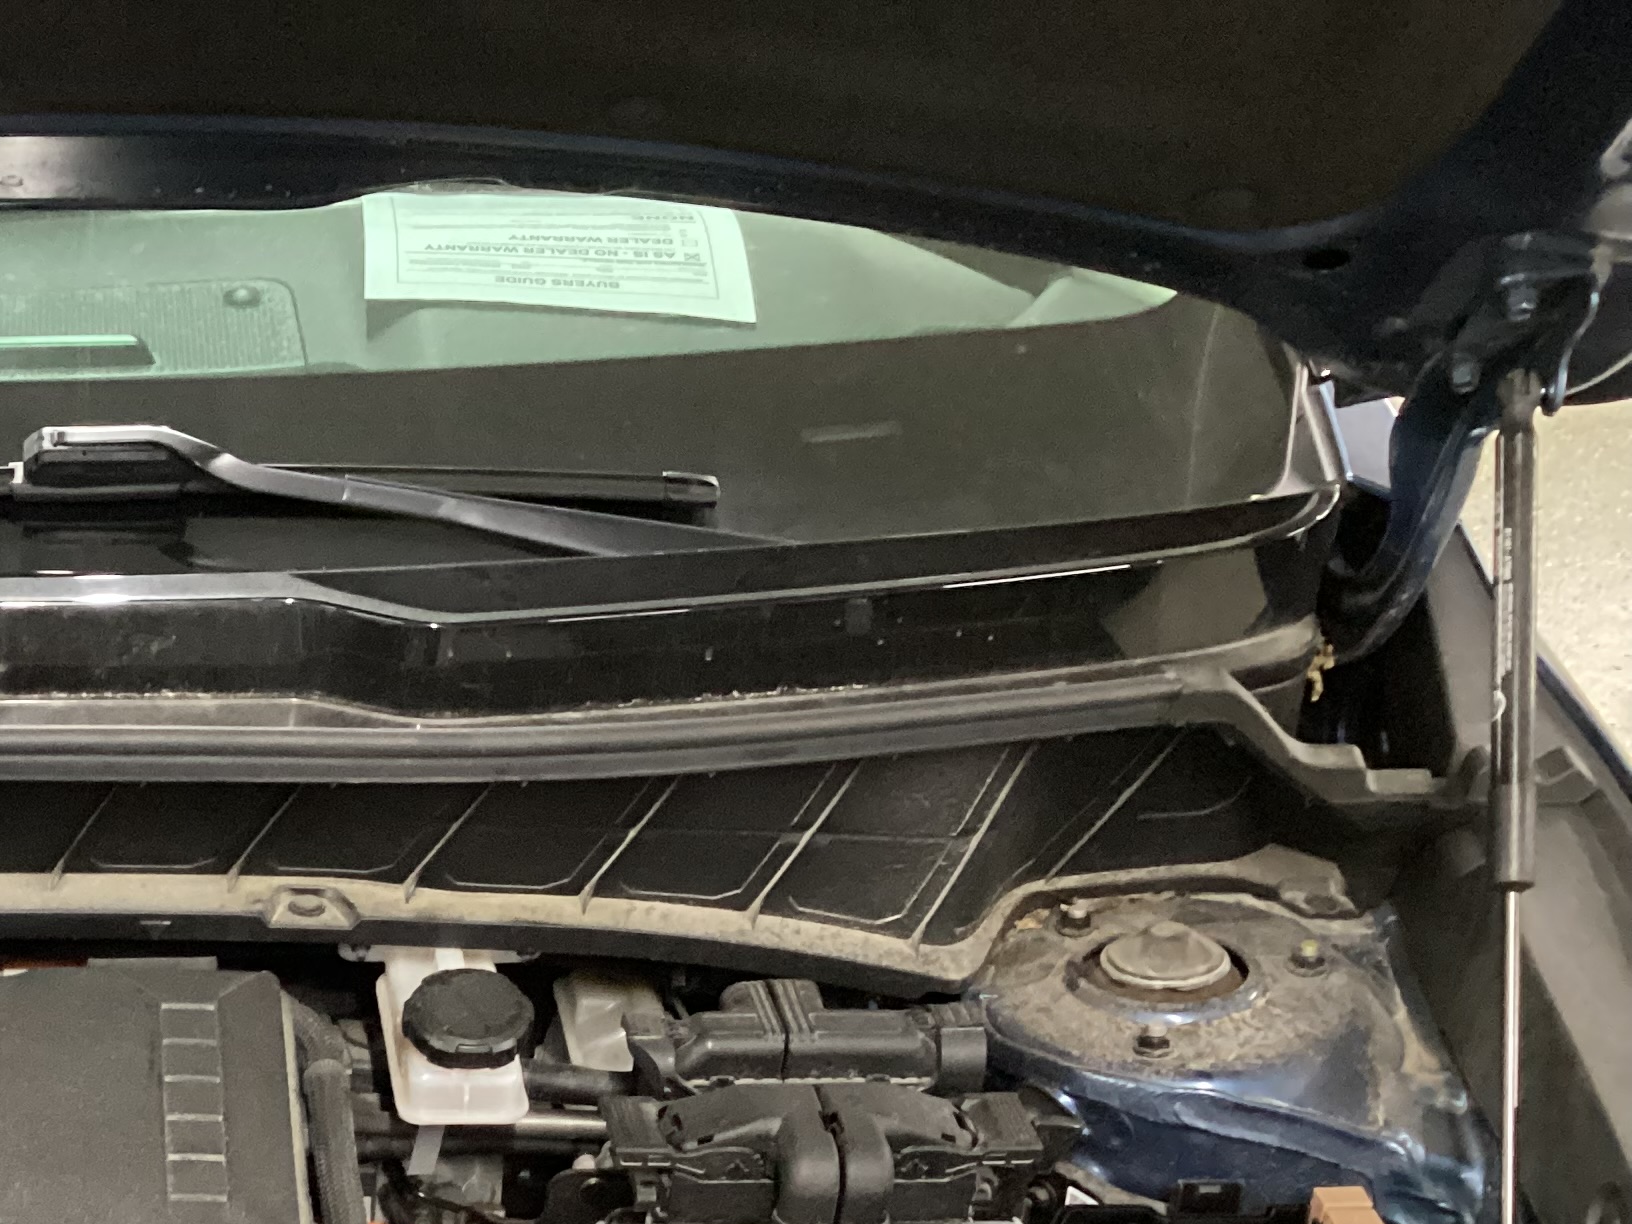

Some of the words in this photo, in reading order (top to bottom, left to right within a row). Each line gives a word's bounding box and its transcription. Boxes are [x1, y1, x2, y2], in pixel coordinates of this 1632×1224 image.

[508, 234, 603, 244] WARRANTY
[607, 237, 674, 245] DEALER
[424, 244, 519, 254] WARRANTY
[523, 247, 590, 256] DEALER
[594, 249, 619, 257] NO
[494, 276, 547, 287] GUIDE
[551, 279, 620, 289] BUYERS
